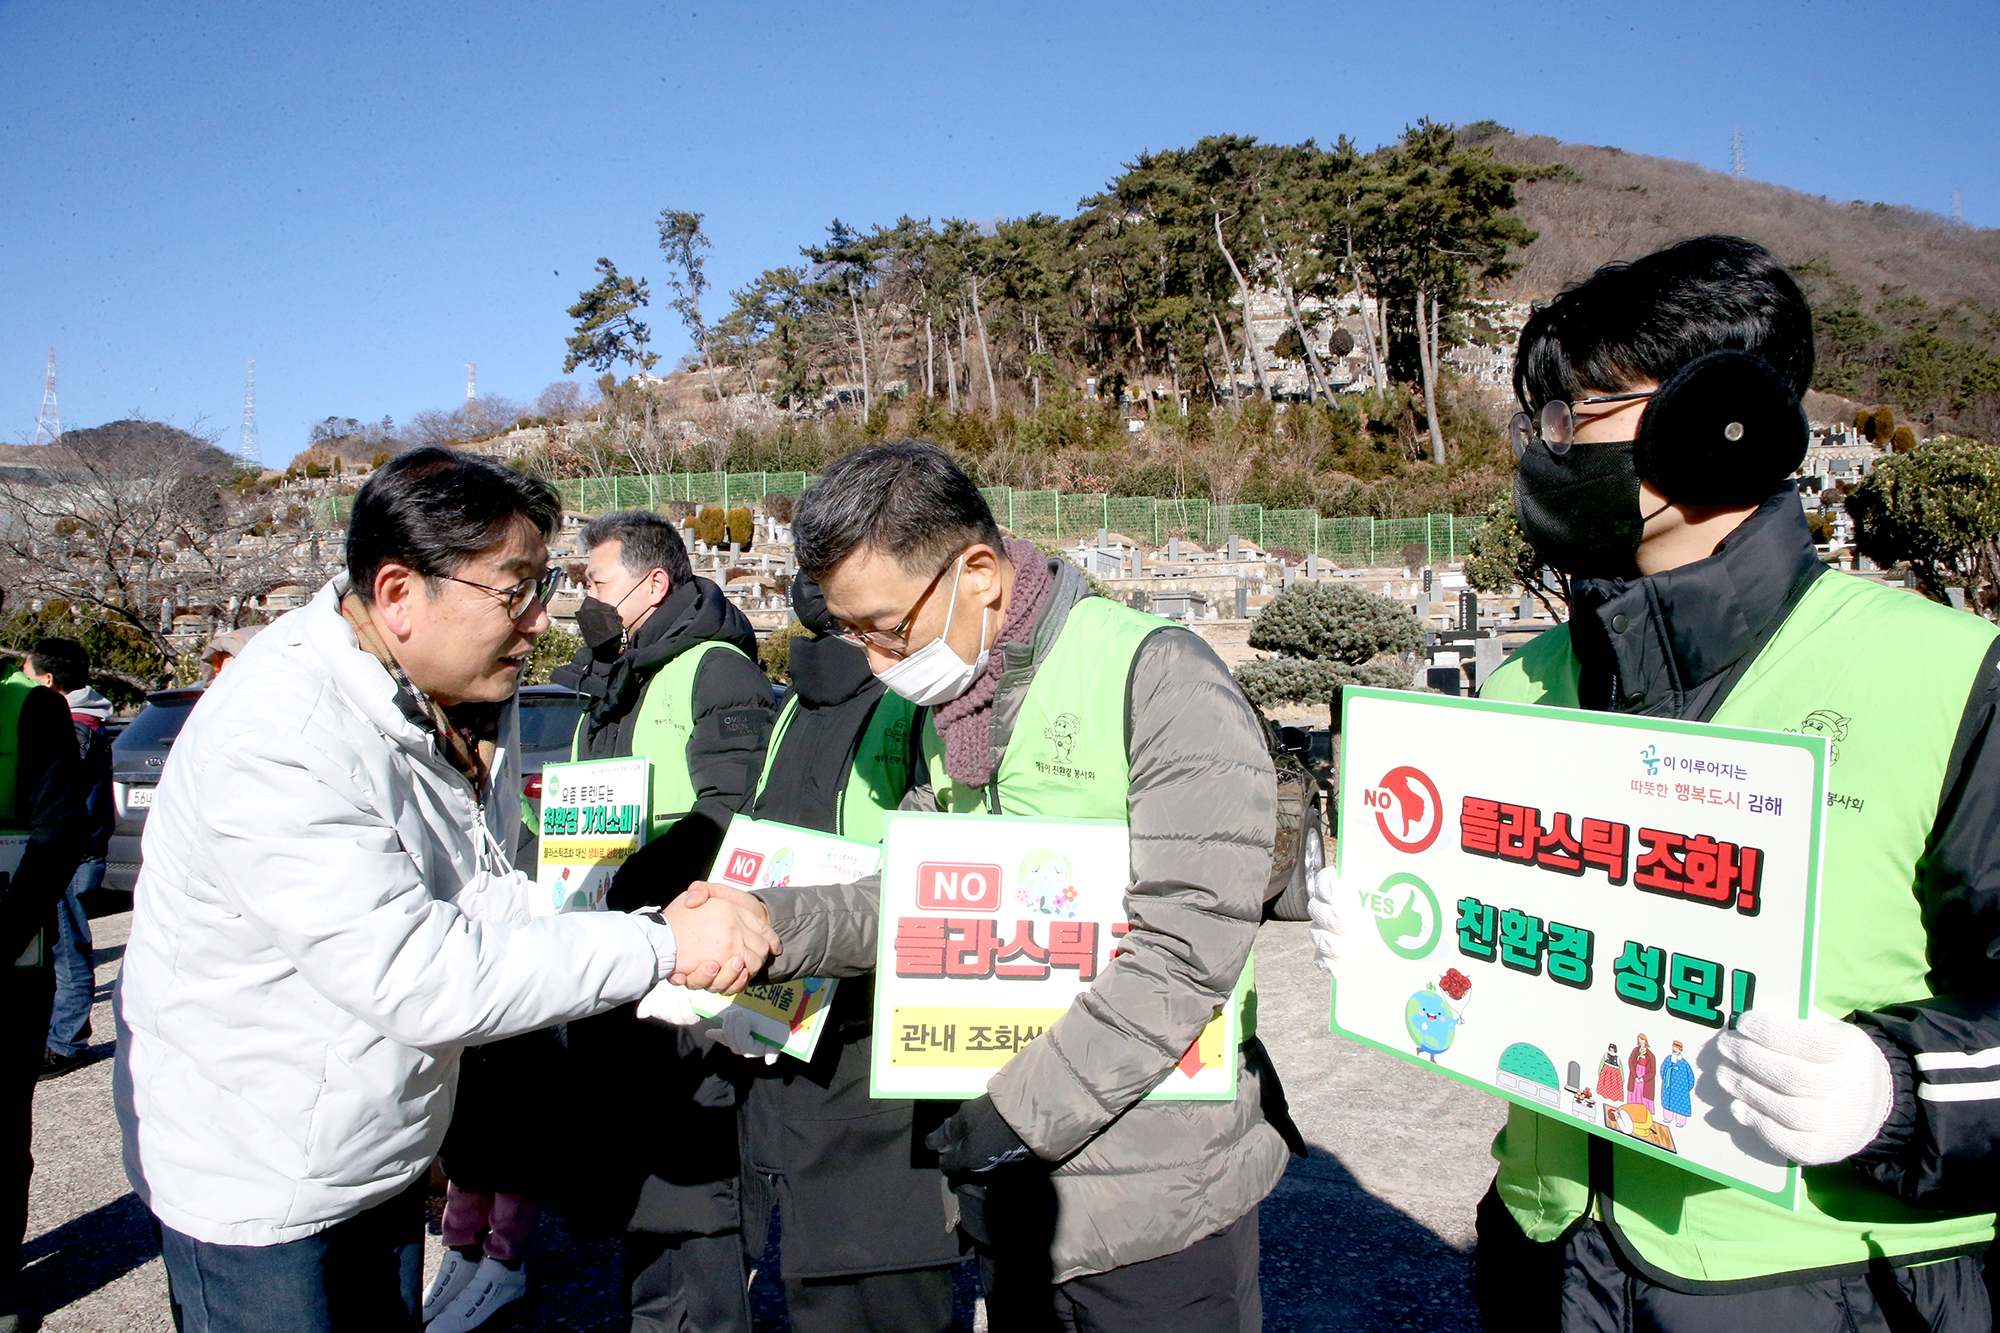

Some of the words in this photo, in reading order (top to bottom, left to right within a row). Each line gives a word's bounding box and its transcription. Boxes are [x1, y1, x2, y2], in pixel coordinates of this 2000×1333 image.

[1052, 765, 1072, 778] 친환경
[1074, 768, 1095, 780] 봉사회
[1640, 744, 1675, 776] 꿈이
[1680, 758, 1748, 781] 이루어지는
[550, 782, 559, 791] YES
[562, 787, 577, 804] 요즘
[581, 784, 614, 803] 트렌드는
[1364, 788, 1392, 810] NO
[1630, 780, 1669, 798] 따뜻한
[1674, 783, 1741, 810] 행복도시
[1748, 793, 1783, 816] 김해
[1827, 791, 1864, 813] 봉사회
[544, 806, 579, 836] 친환경
[581, 804, 640, 836] 가치소비!
[575, 847, 587, 859] 대신
[730, 855, 757, 878] NO
[1460, 795, 1629, 887] 플라스틱
[1635, 826, 1764, 917] 조화!
[933, 871, 987, 902] NO
[1357, 889, 1395, 916] YES
[894, 916, 1100, 982] 플라스틱
[1455, 896, 1594, 990] 친환경
[1613, 939, 1757, 1031] 성묘!
[900, 1023, 956, 1053] 관내
